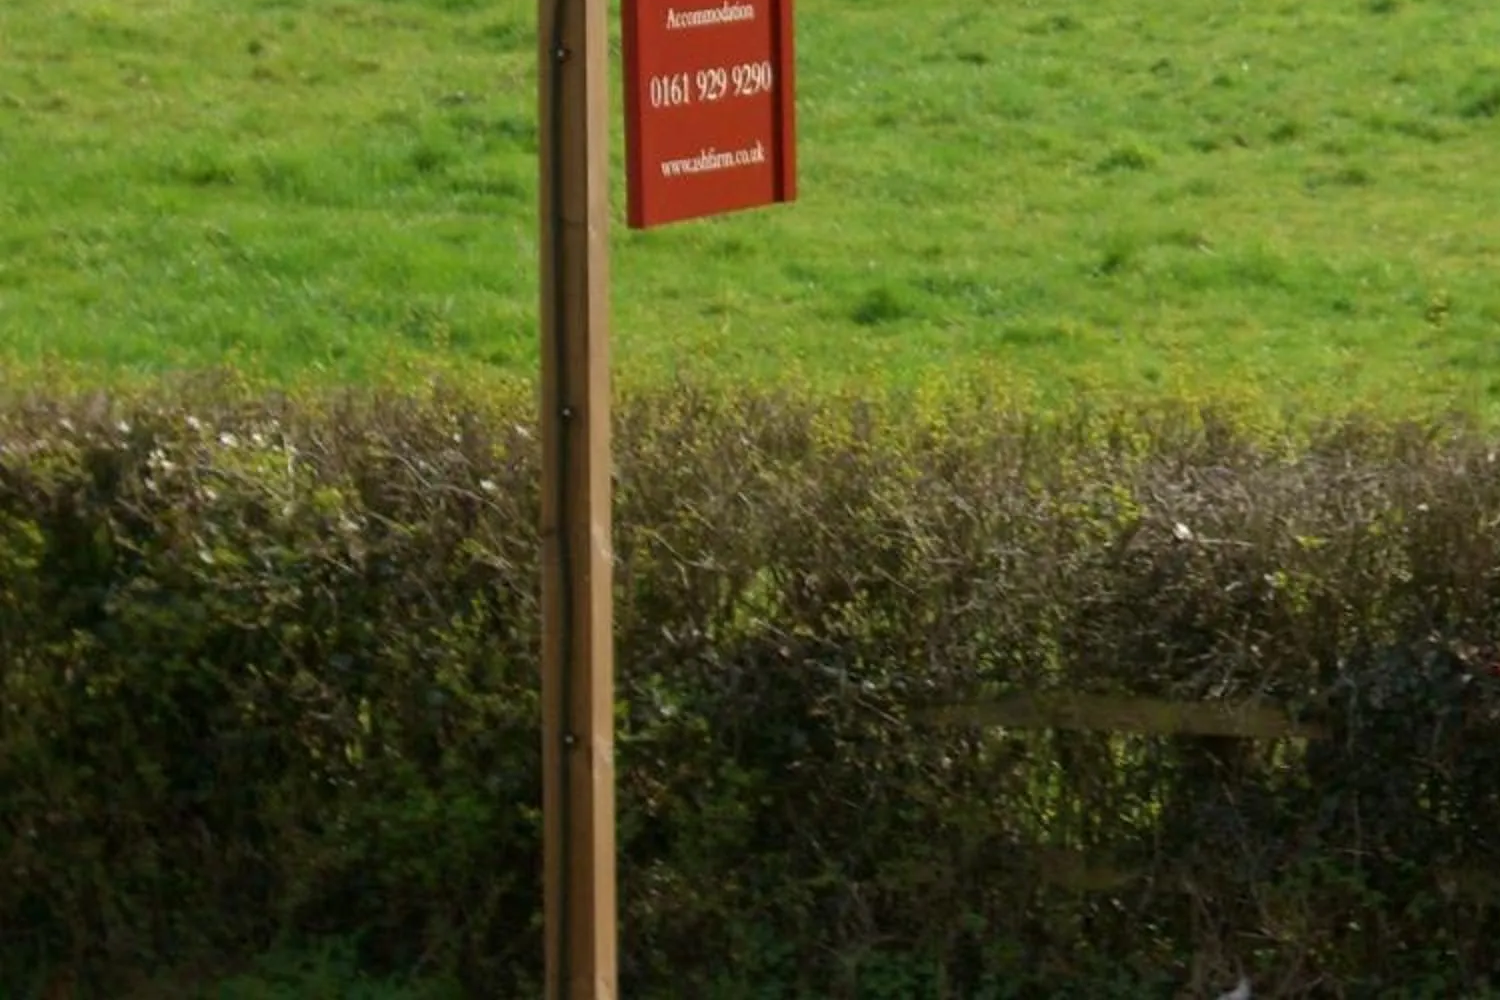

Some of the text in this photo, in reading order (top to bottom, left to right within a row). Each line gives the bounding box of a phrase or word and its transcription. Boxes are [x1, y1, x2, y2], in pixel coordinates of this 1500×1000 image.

[666, 0, 755, 30] Accommodation
[650, 61, 773, 108] 0161 929 9290
